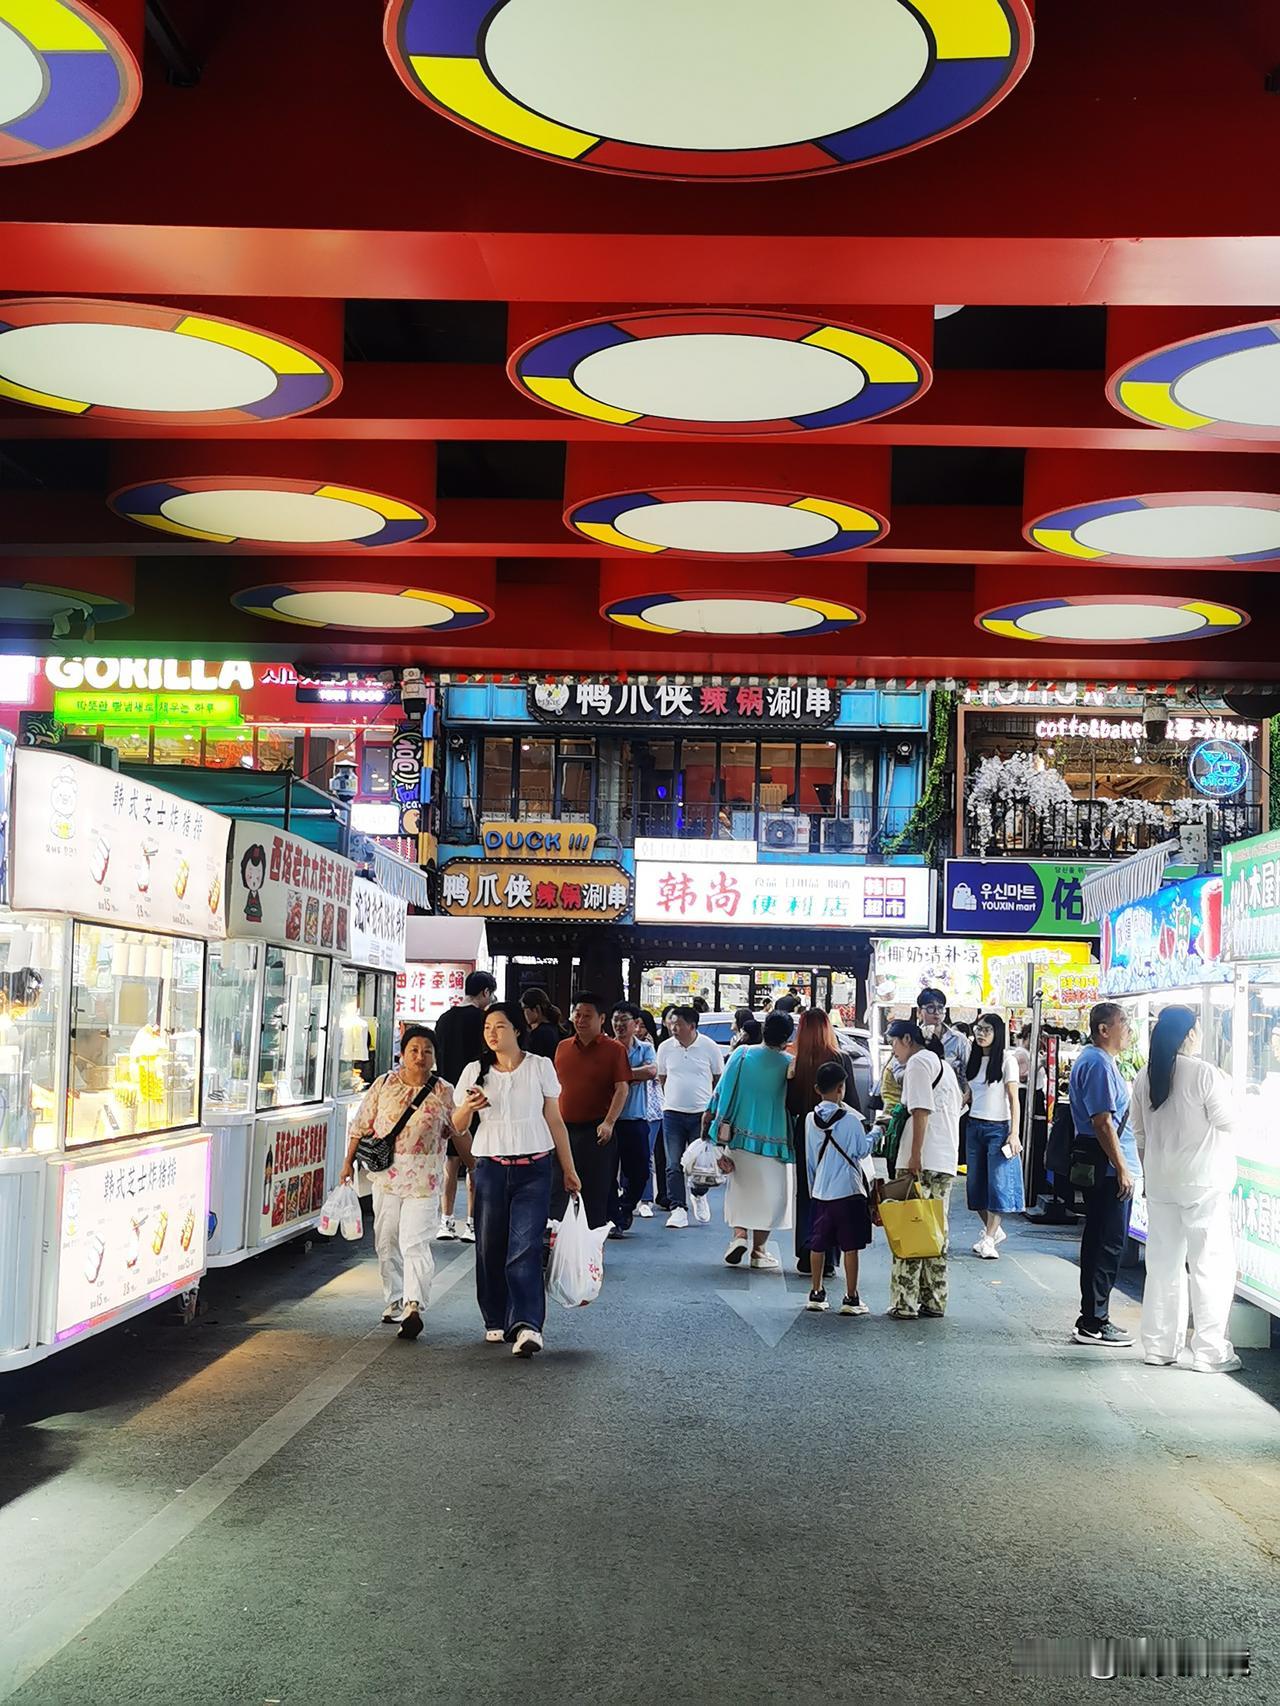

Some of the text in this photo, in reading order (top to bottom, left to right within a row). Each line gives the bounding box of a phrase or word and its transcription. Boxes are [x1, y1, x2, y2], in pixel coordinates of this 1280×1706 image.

[45, 656, 254, 690] GORILLA
[195, 702, 215, 713] 하루
[575, 684, 832, 718] 鸭爪侠辣锅涮串
[485, 831, 590, 851] DUCK !!!
[442, 872, 628, 911] 鸭爪侠辣锅涮串
[656, 871, 742, 918] 韩尚
[864, 877, 906, 897] 韩国
[980, 882, 1037, 901] 우신마트
[753, 894, 851, 918] 便利店
[864, 898, 906, 918] 超市
[980, 902, 1036, 912] YOUXIN mart
[1051, 876, 1084, 921] 佑
[888, 946, 980, 964] 椰奶清补凉
[103, 1156, 177, 1203] 韩式芝士炸猪排
